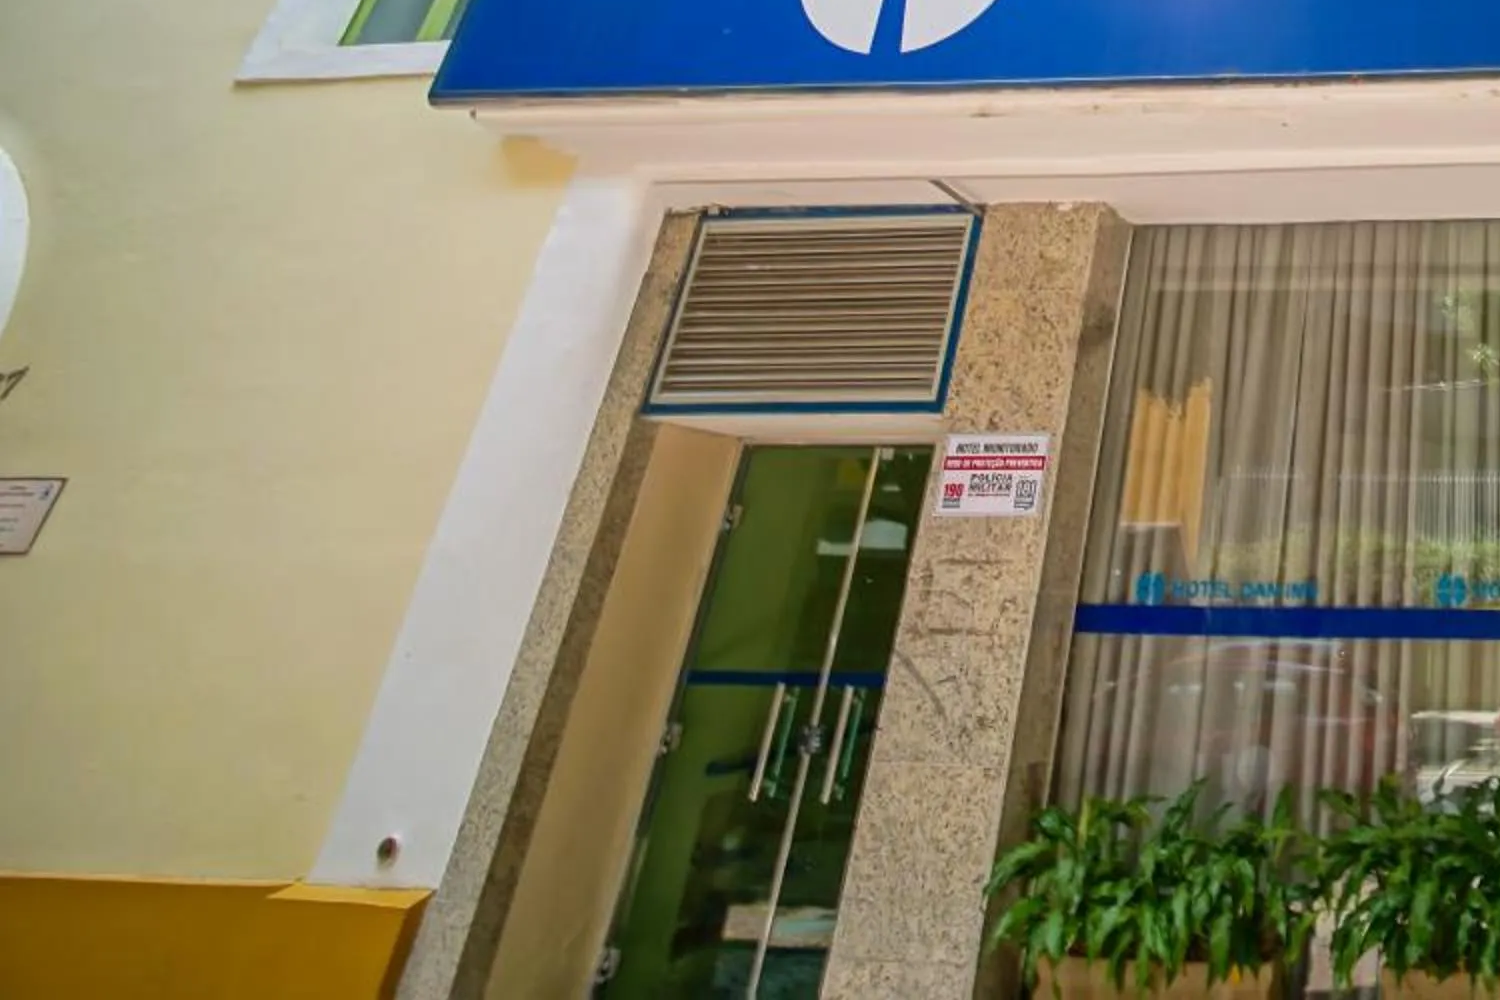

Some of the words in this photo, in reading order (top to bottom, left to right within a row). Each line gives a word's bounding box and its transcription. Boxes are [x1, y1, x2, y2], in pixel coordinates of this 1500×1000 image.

[944, 483, 965, 497] 190
[1171, 579, 1233, 600] HOTEL
[1239, 579, 1279, 600] DAN
